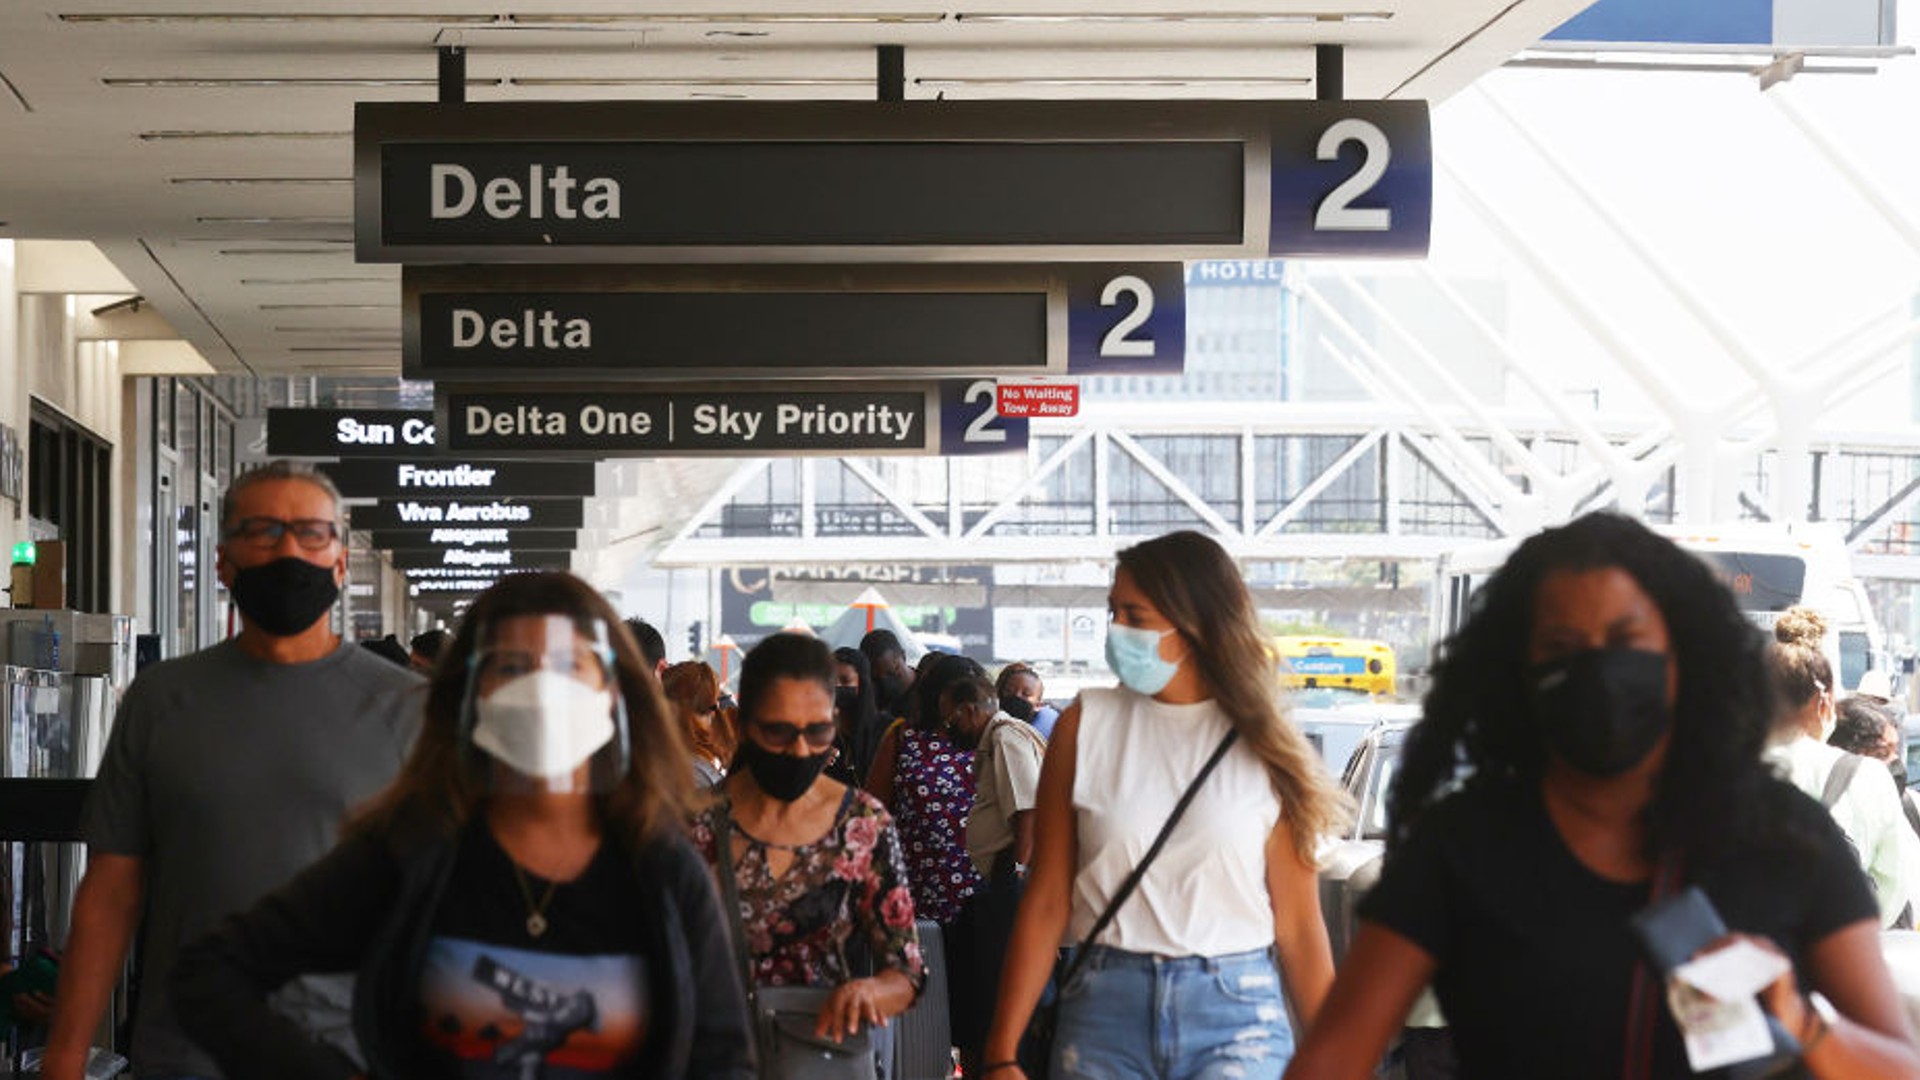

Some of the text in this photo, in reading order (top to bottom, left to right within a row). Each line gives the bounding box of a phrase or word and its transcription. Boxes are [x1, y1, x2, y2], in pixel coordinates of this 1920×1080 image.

[1315, 119, 1391, 231] 2
[432, 164, 621, 219] Delta
[1201, 262, 1281, 280] HOTEL
[453, 310, 591, 348] Delta
[1100, 275, 1156, 356] 2
[1003, 388, 1072, 401] No Waiting
[1003, 402, 1028, 413] Tow
[1039, 402, 1072, 415] Away
[467, 405, 652, 434] Delta One
[693, 403, 914, 441] Sky Priority
[964, 380, 1007, 442] 2
[337, 418, 395, 444] Sun
[398, 464, 496, 487] Frontier
[397, 501, 531, 521] Viva Aerobus
